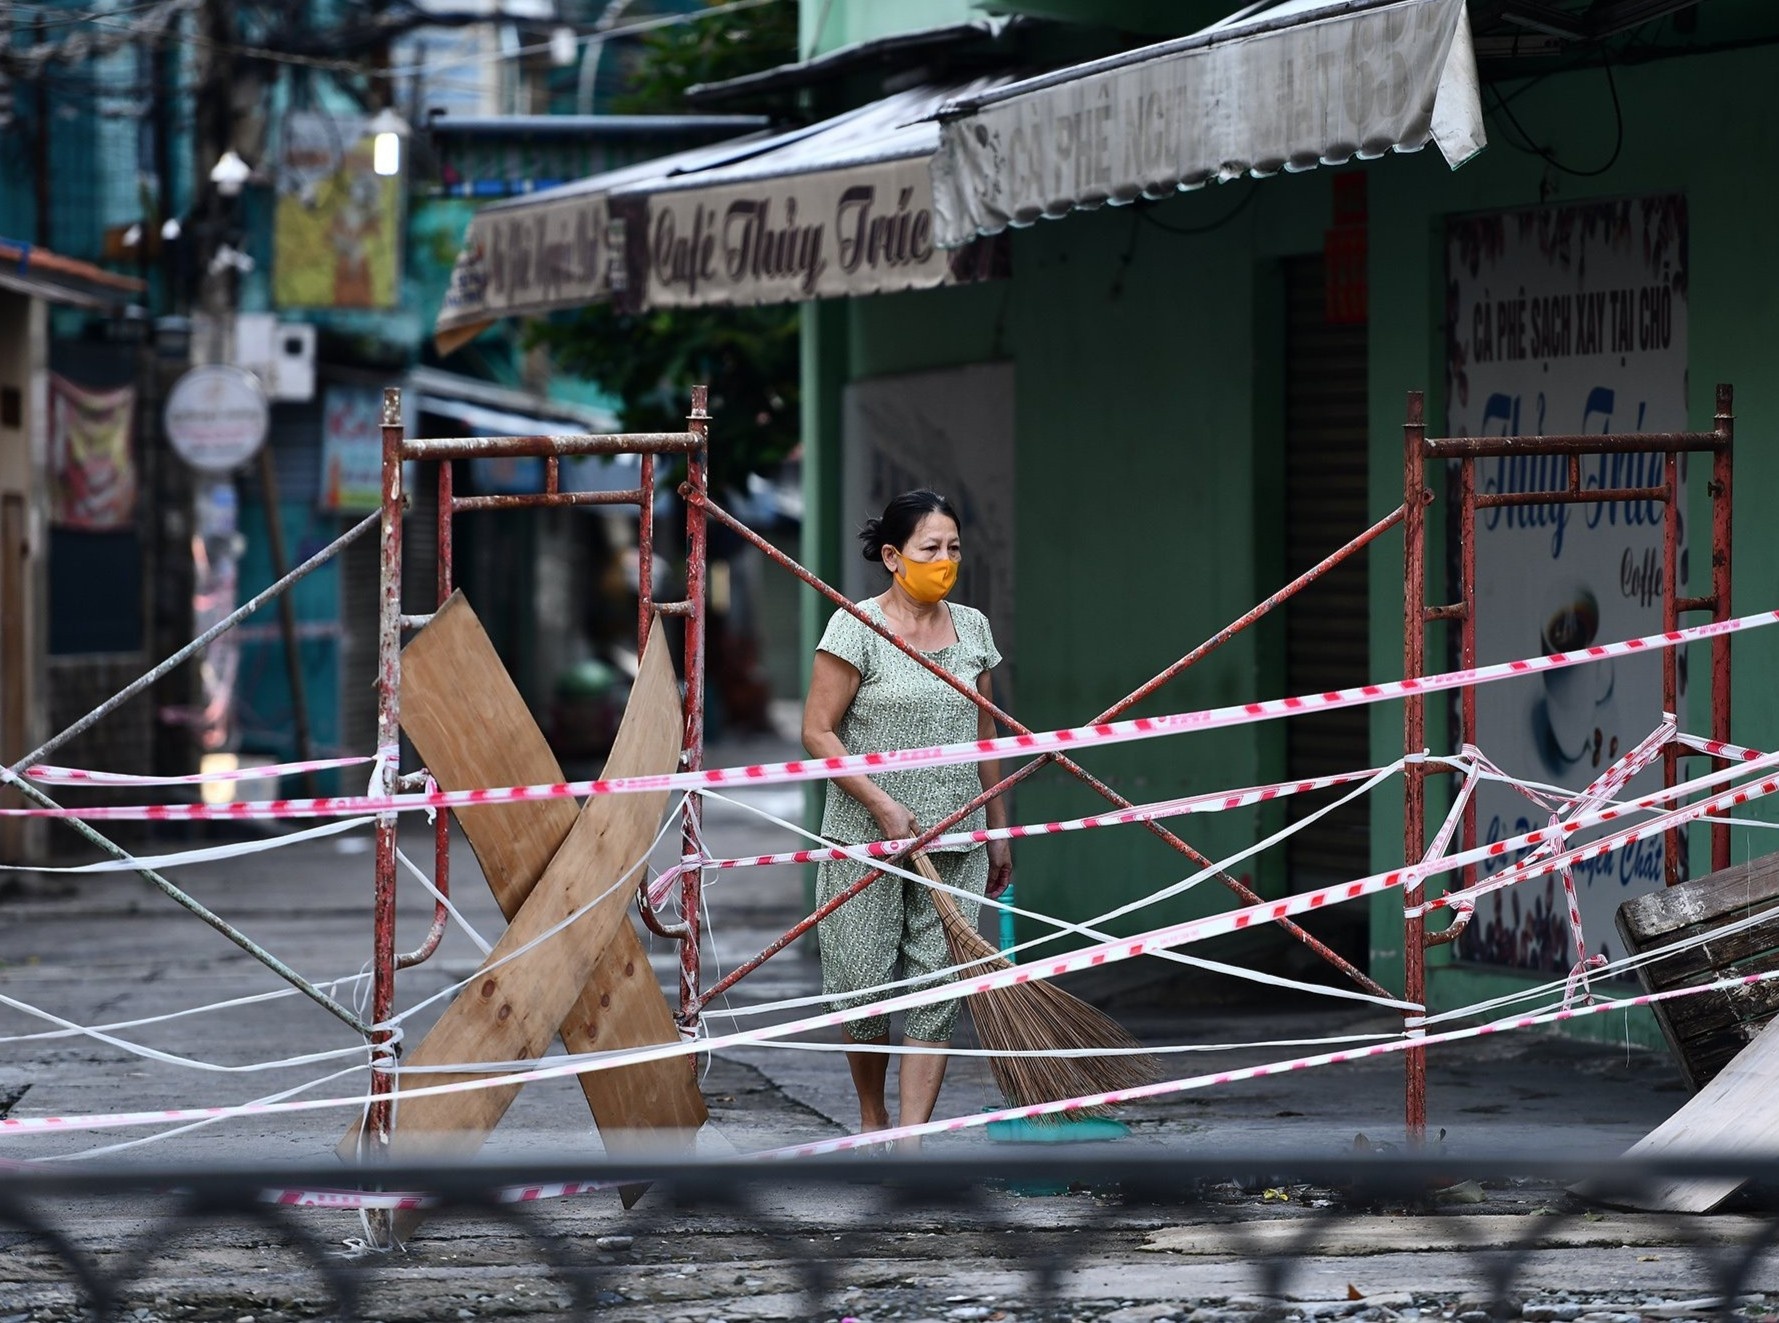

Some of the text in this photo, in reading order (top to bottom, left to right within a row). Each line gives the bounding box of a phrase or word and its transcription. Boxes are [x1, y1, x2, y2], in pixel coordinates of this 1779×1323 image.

[653, 200, 717, 297] Café
[836, 184, 933, 275] Trúc
[1473, 261, 1672, 373] CÀ PHÊ SẠCH XAY TẠI CHỖ
[1481, 386, 1665, 560] Thủy Trúc
[1620, 546, 1666, 608] Coffe
